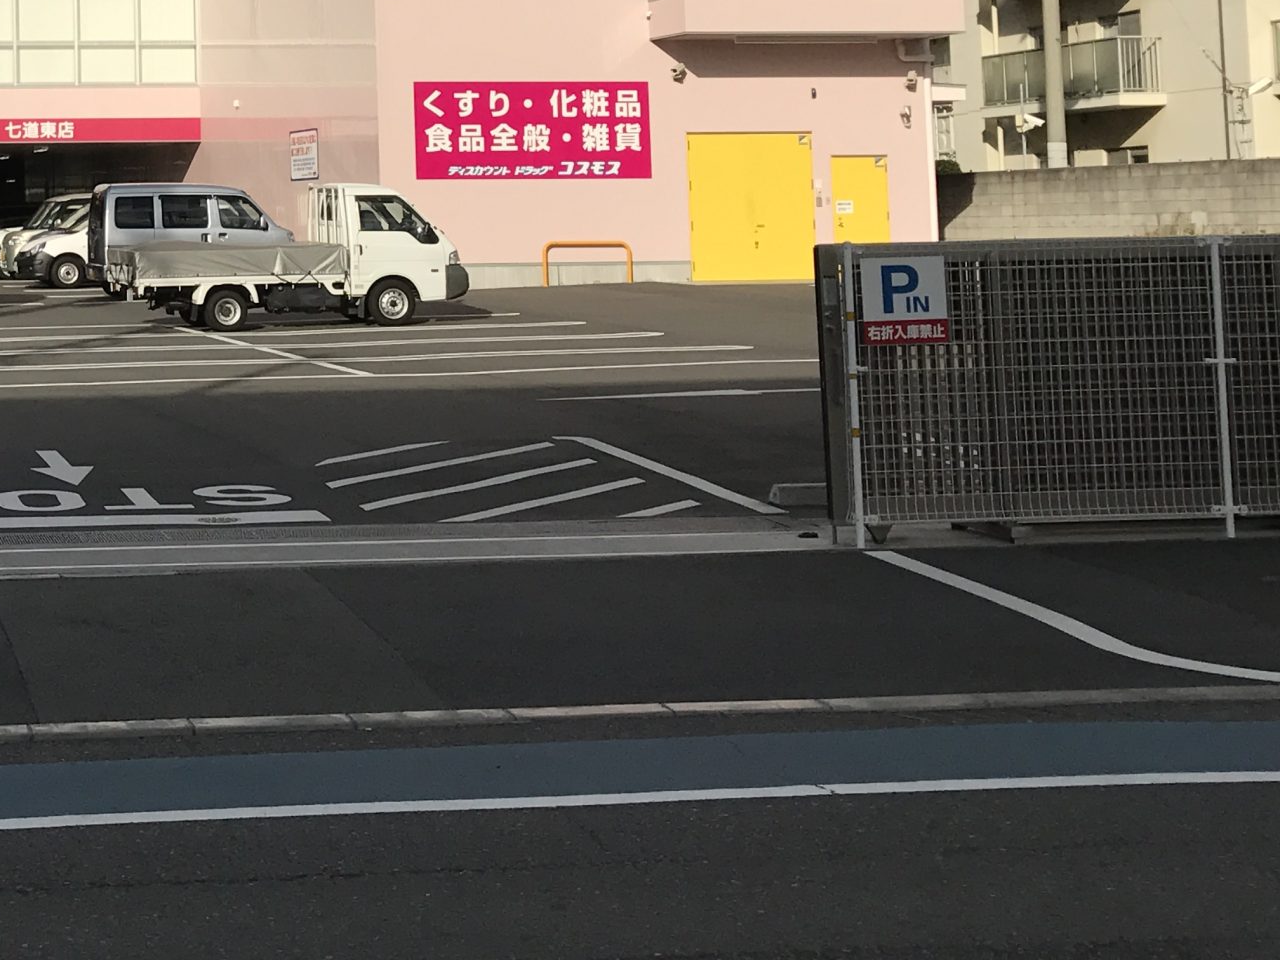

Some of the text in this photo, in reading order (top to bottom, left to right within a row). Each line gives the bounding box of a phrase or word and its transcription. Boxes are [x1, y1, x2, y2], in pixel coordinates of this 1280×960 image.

[422, 88, 642, 119] くすり・化粧品
[5, 121, 75, 140] 七道東店
[424, 123, 642, 153] 食品全般・雑貨
[447, 161, 621, 176] ディスカウント ドラッグ コスモス
[880, 265, 930, 314] P IN
[867, 323, 946, 341] 右折入庫禁止
